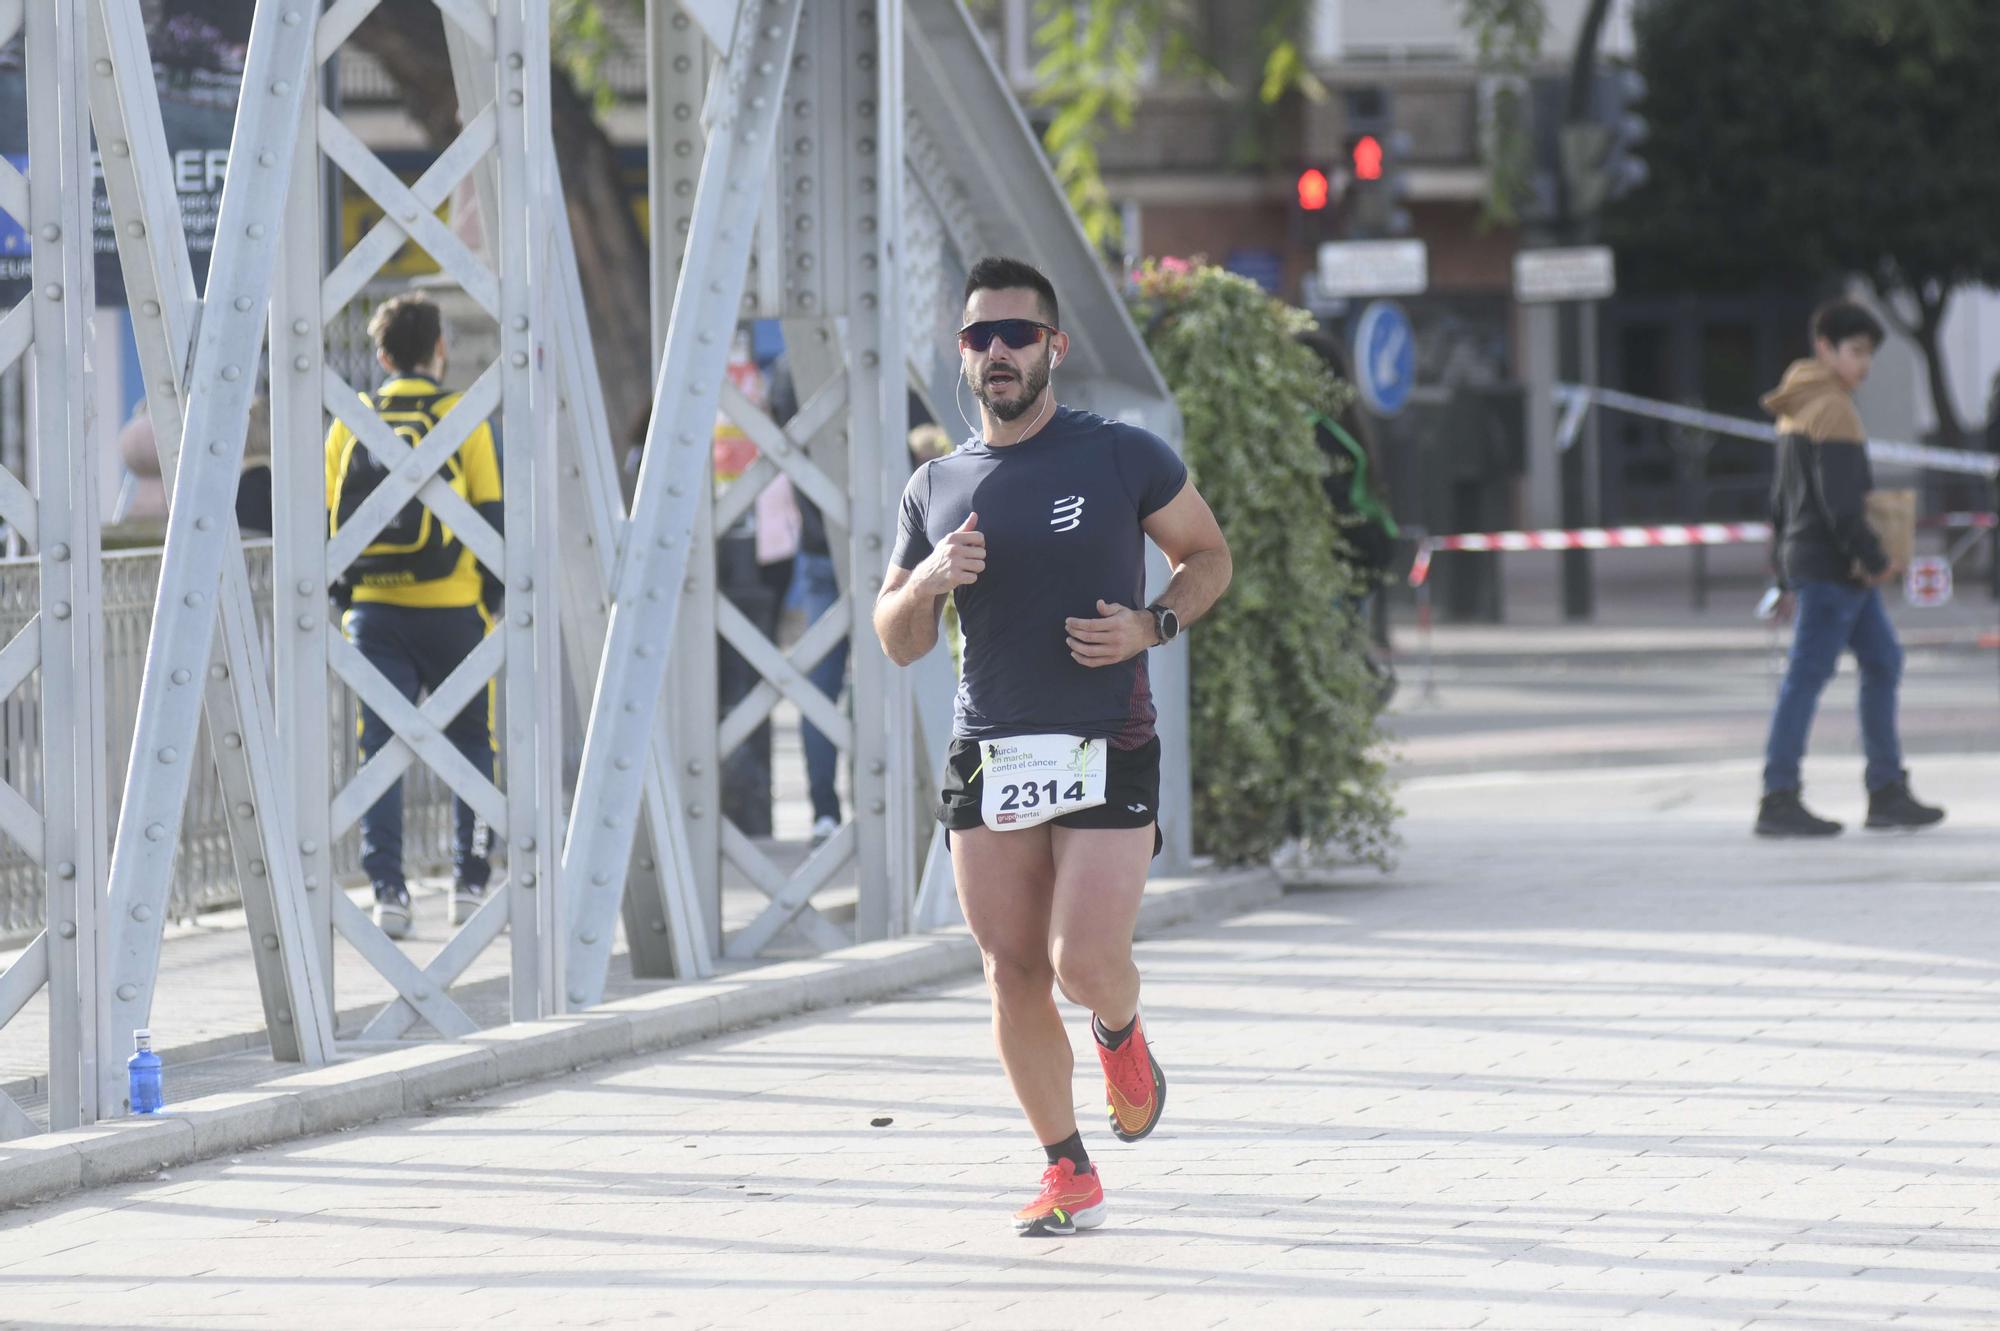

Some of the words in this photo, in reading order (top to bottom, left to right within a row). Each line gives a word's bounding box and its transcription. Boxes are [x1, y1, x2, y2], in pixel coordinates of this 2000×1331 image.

[1003, 752, 1033, 763] marcha
[992, 763, 1017, 772] contra
[1018, 760, 1026, 768] el
[1027, 759, 1057, 767] cáncer
[1000, 780, 1085, 810] 2314
